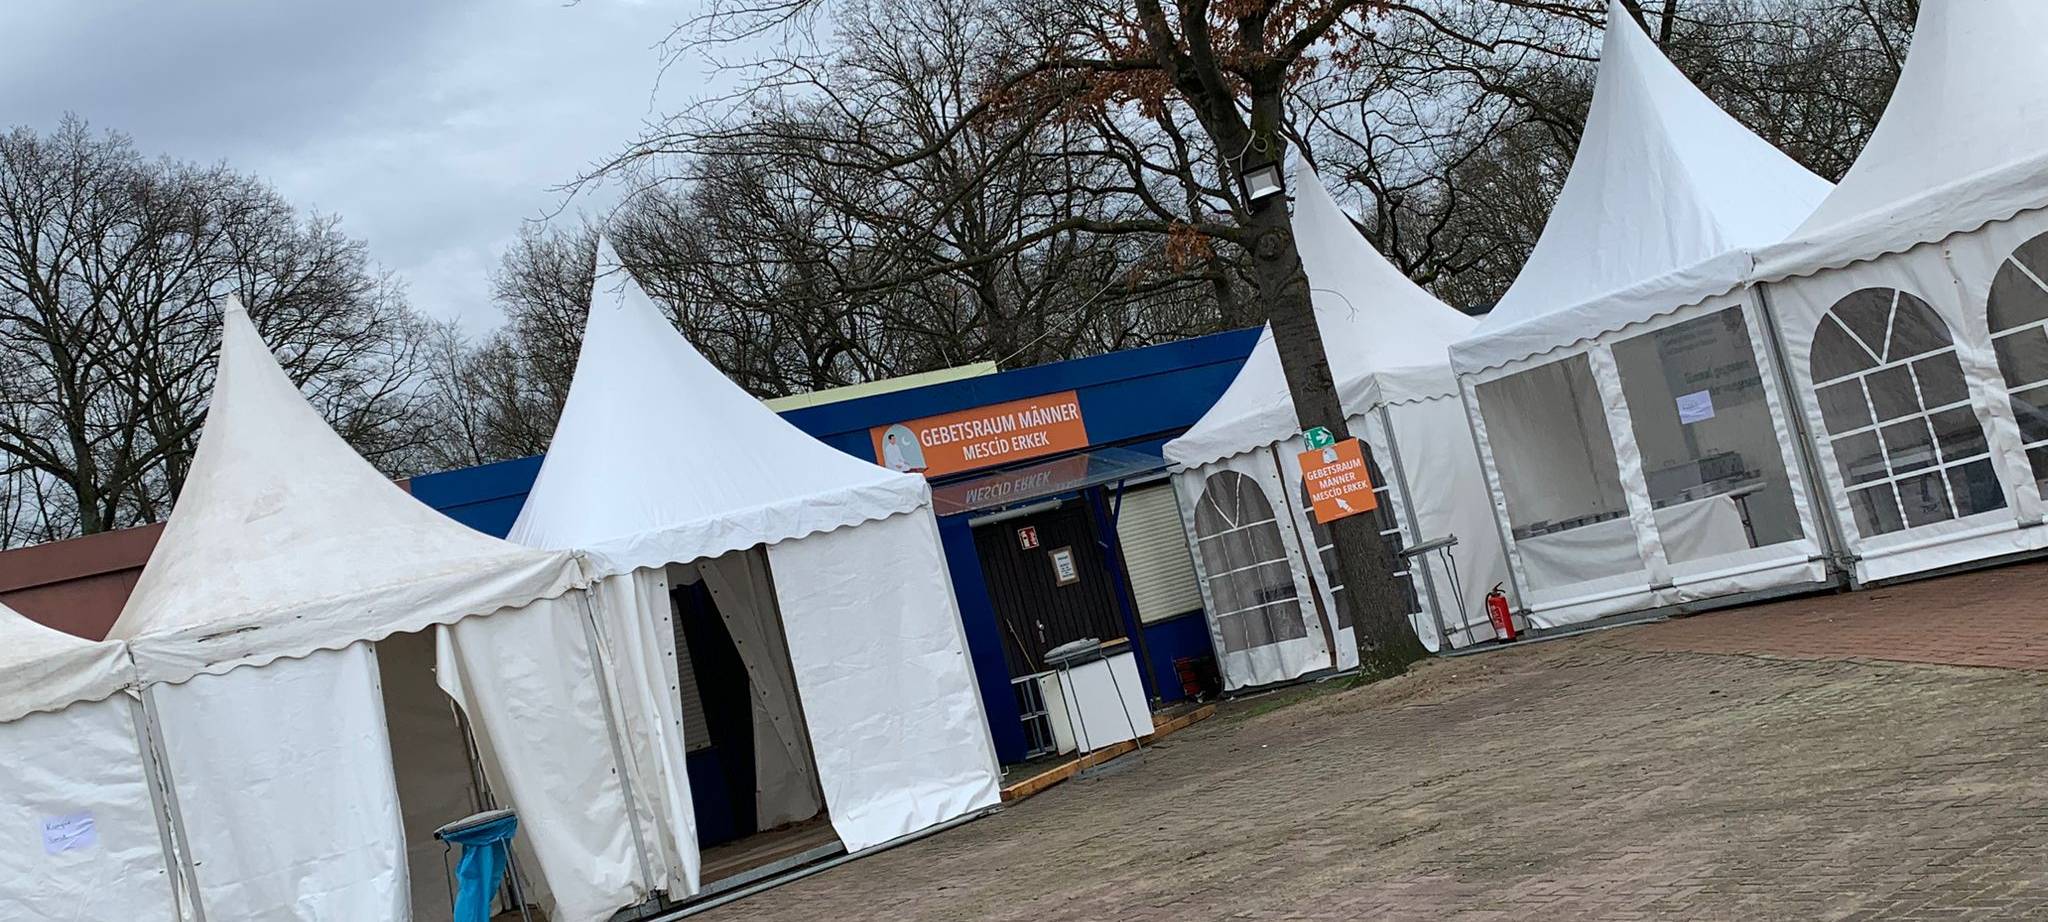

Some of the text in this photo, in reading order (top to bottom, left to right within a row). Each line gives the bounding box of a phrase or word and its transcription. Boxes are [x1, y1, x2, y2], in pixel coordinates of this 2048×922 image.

[921, 403, 1079, 447] GEBETSRAUM MÄNNER
[963, 431, 1049, 461] MESCİD ERKEK
[1307, 459, 1362, 481] GEBETSRAUM
[1319, 472, 1356, 490] MÄNNER
[1343, 480, 1368, 494] ERKEK
